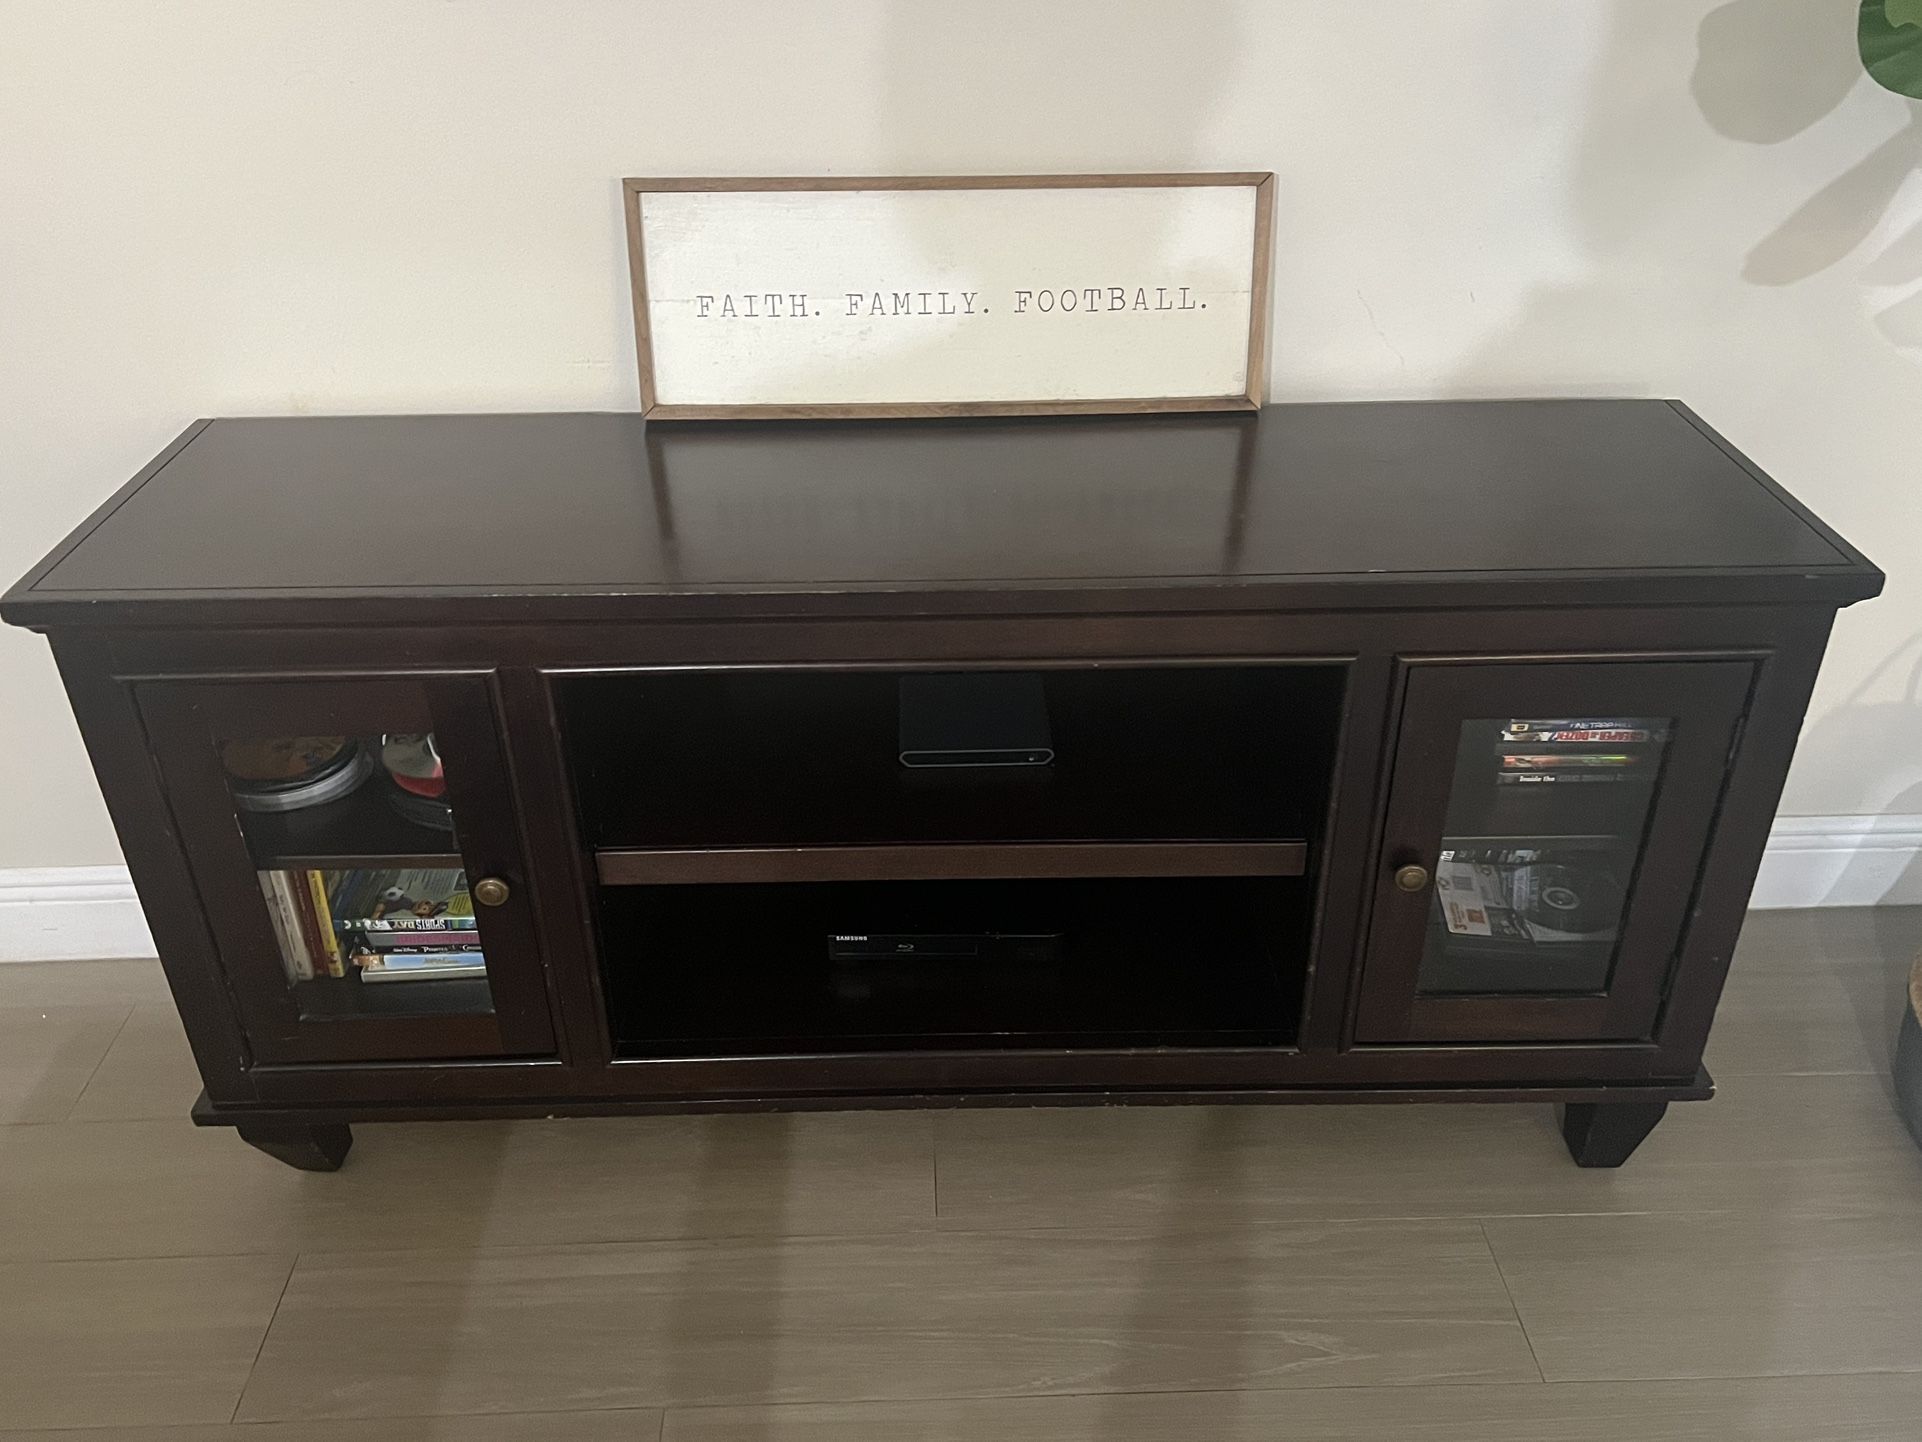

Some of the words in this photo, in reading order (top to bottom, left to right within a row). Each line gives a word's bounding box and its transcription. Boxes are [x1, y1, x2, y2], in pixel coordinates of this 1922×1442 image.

[695, 293, 822, 318] FAITH.
[845, 292, 990, 317] FAMILY.
[1013, 287, 1208, 314] FOOTBALL.
[393, 920, 415, 930] DAY
[416, 919, 446, 930] SPORTS
